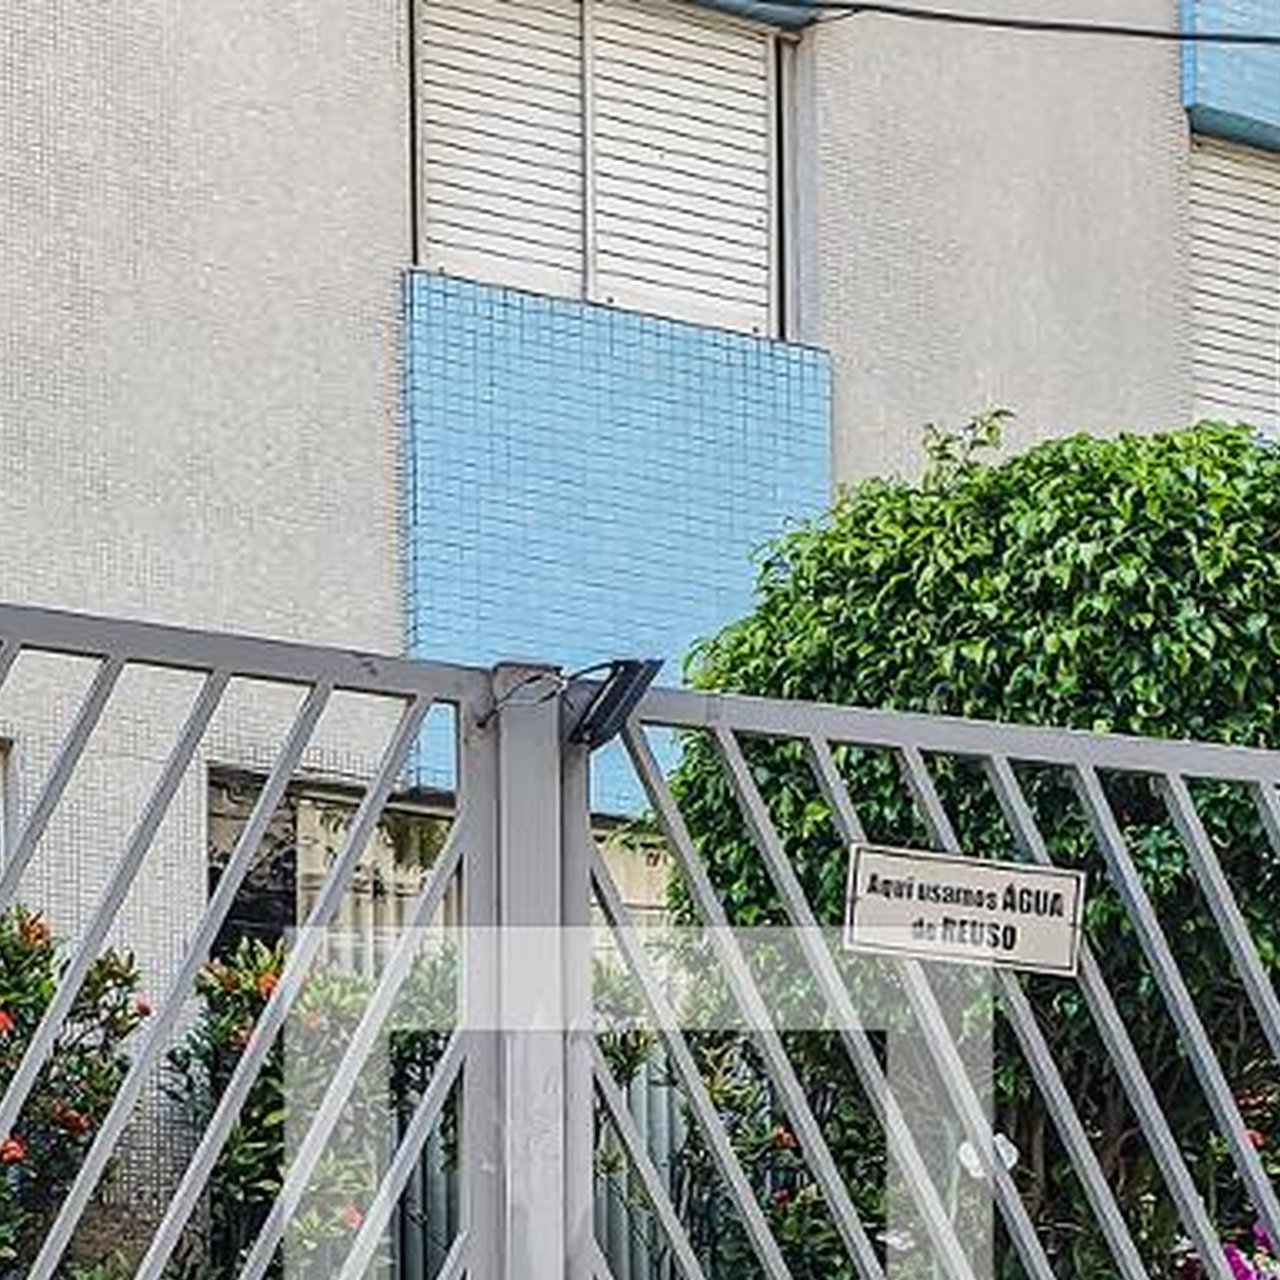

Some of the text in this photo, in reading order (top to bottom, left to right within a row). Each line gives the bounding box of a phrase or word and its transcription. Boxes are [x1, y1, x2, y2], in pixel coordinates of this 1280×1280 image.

[866, 872, 914, 900] Aqui
[919, 879, 998, 911] usamos
[941, 916, 1018, 952] REUSO
